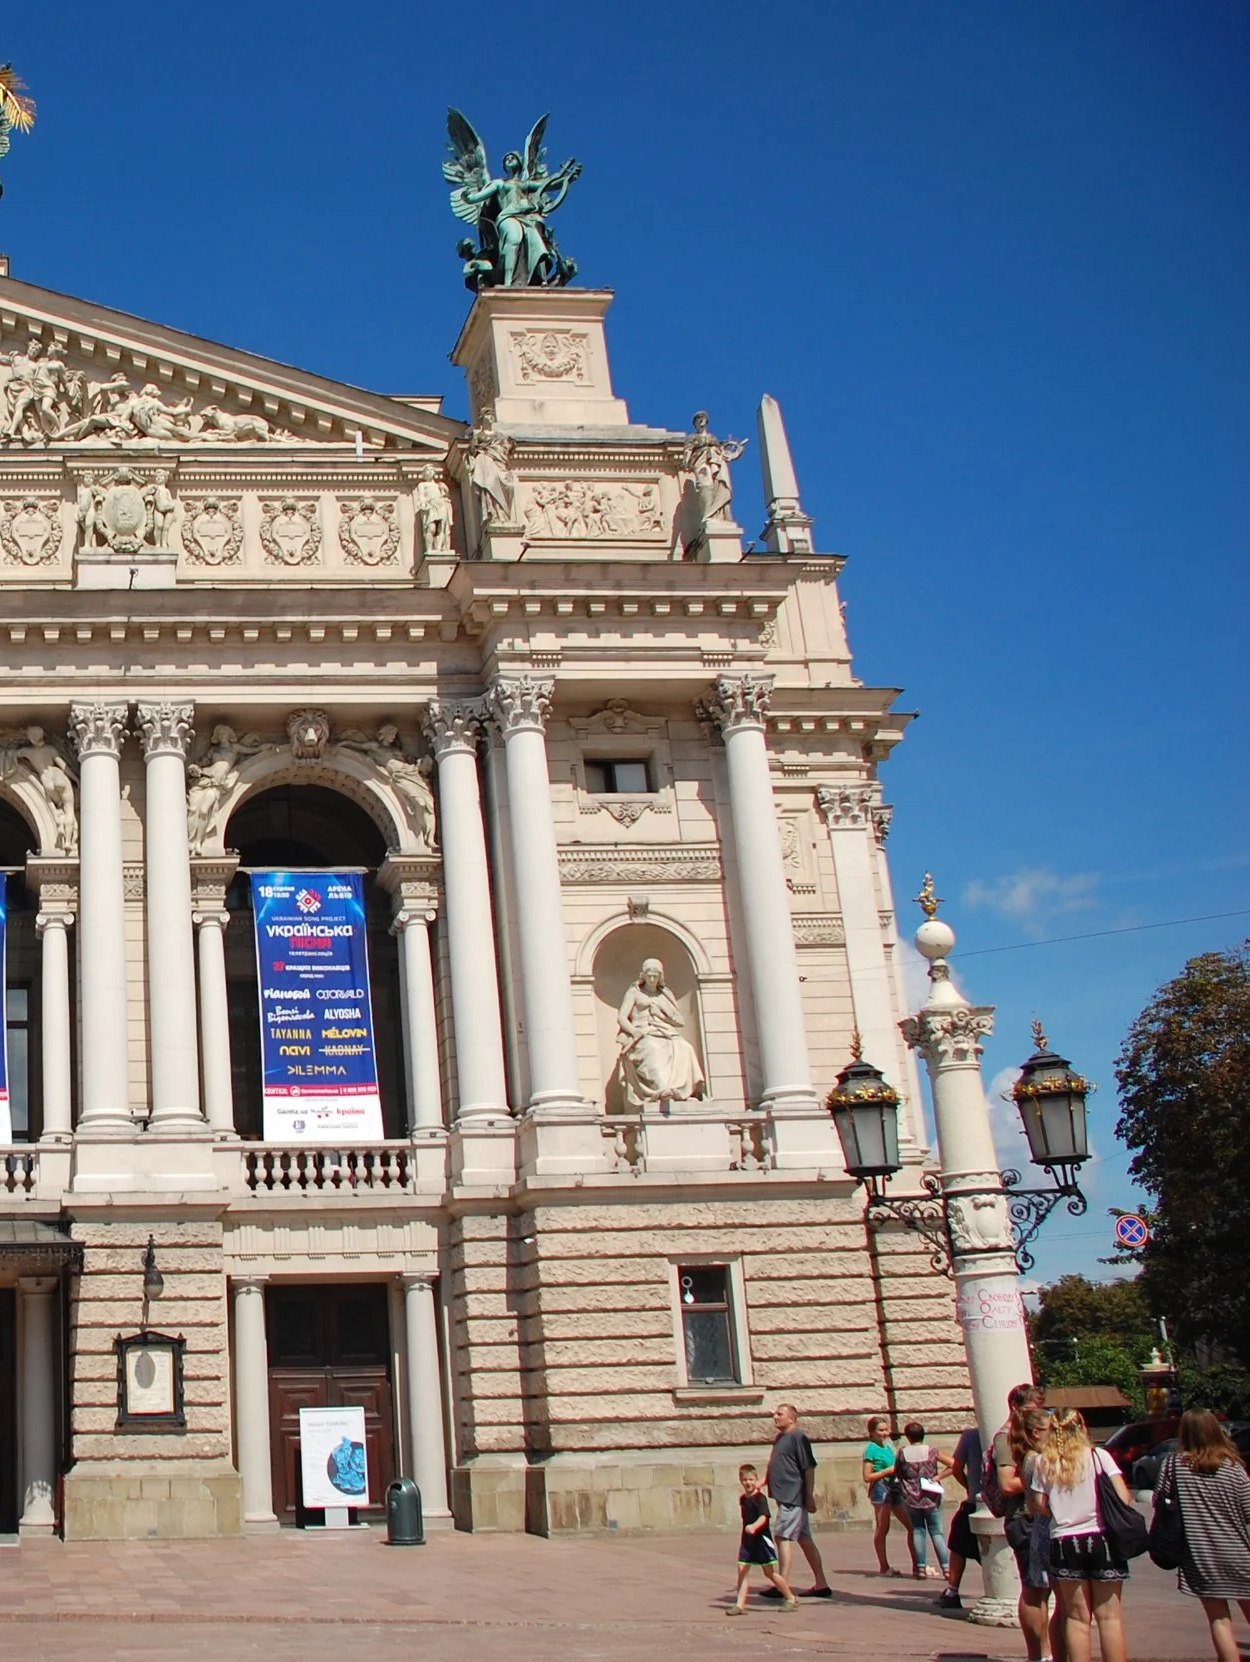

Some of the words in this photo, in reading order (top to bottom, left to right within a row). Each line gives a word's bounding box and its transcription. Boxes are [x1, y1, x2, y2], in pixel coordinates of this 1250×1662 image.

[258, 886, 273, 898] 18
[324, 1008, 361, 1019] ALYOSHA
[271, 1028, 311, 1039] TAYANNA
